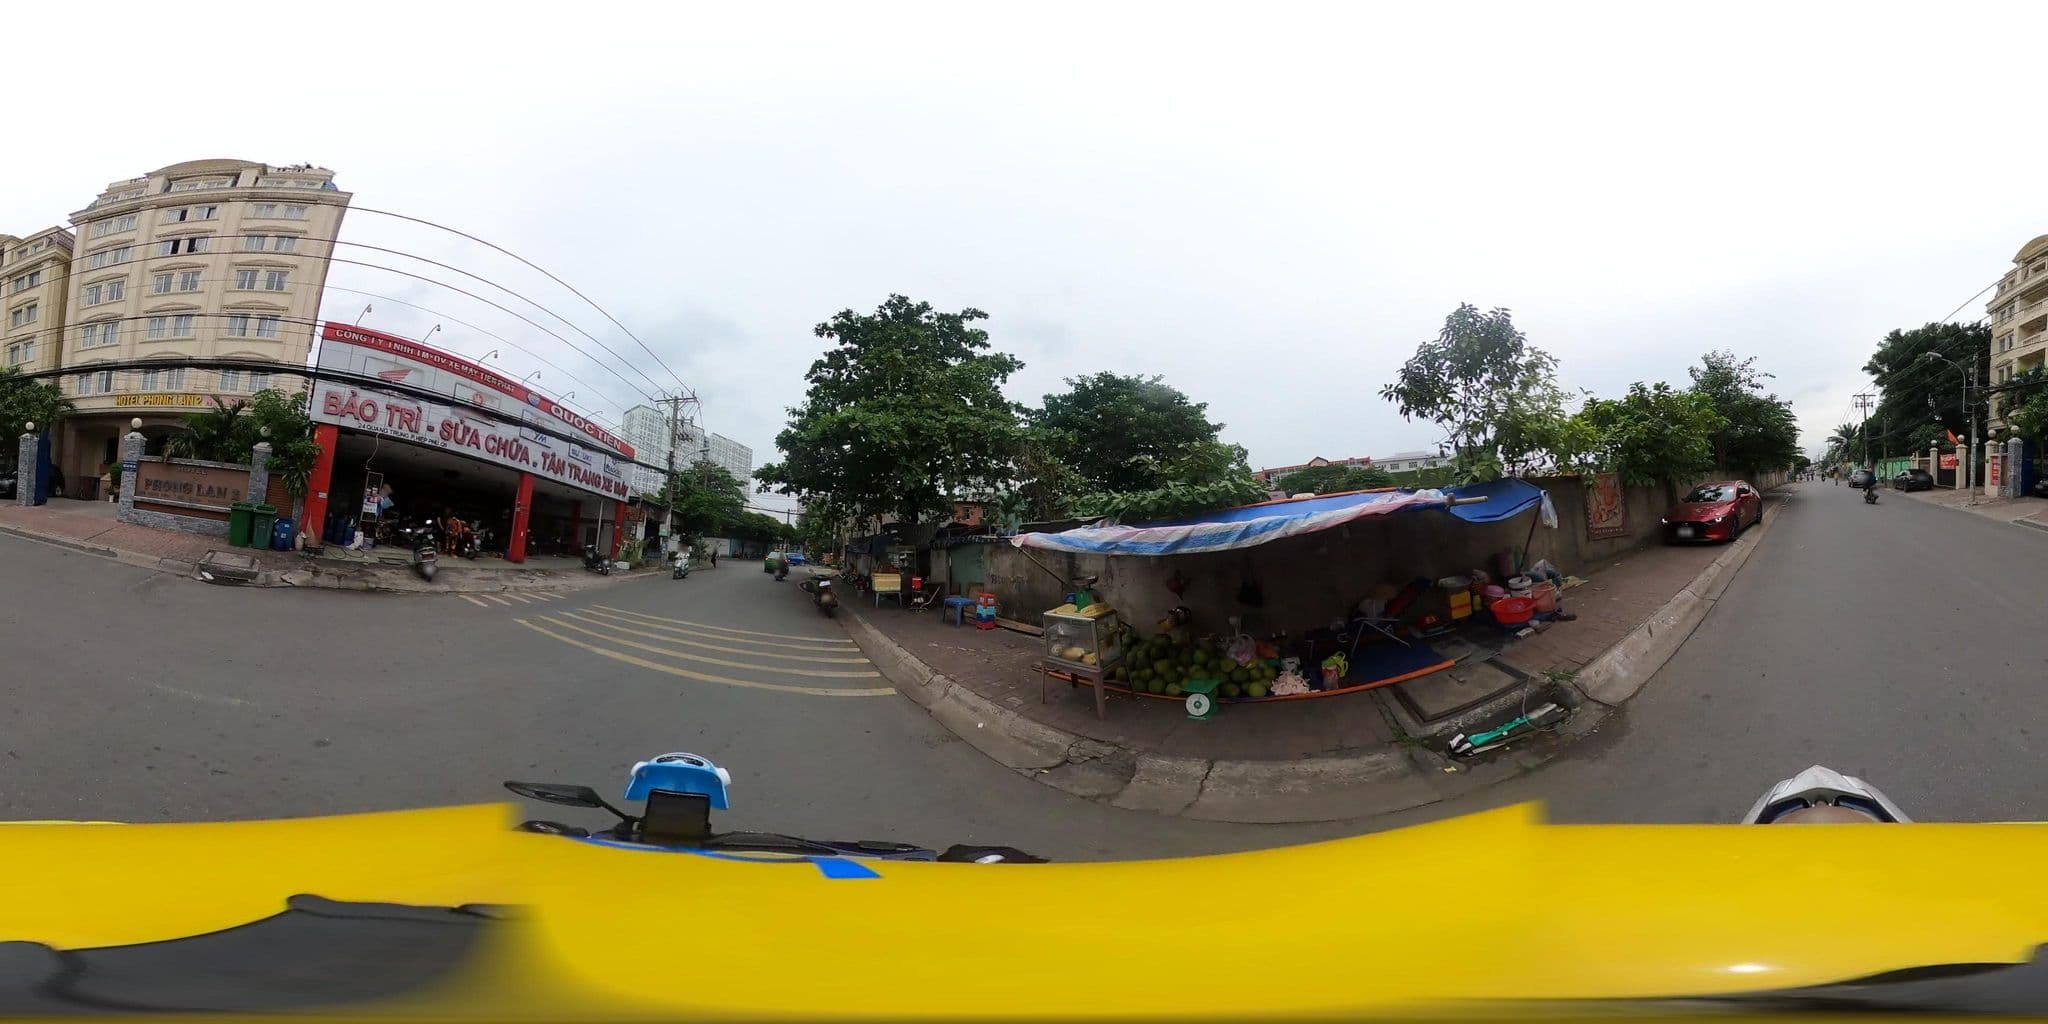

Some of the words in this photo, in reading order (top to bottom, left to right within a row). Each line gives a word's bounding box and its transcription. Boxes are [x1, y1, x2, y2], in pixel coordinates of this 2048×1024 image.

[116, 395, 140, 407] HOTEL
[143, 395, 174, 407] PHONG
[323, 391, 378, 422] BẢO
[386, 404, 423, 434] TRÌ
[439, 419, 481, 451] SỬA
[484, 434, 530, 466] CHỮA
[541, 450, 566, 477] TÂN
[568, 460, 602, 490] TRANG
[601, 474, 613, 493] XE
